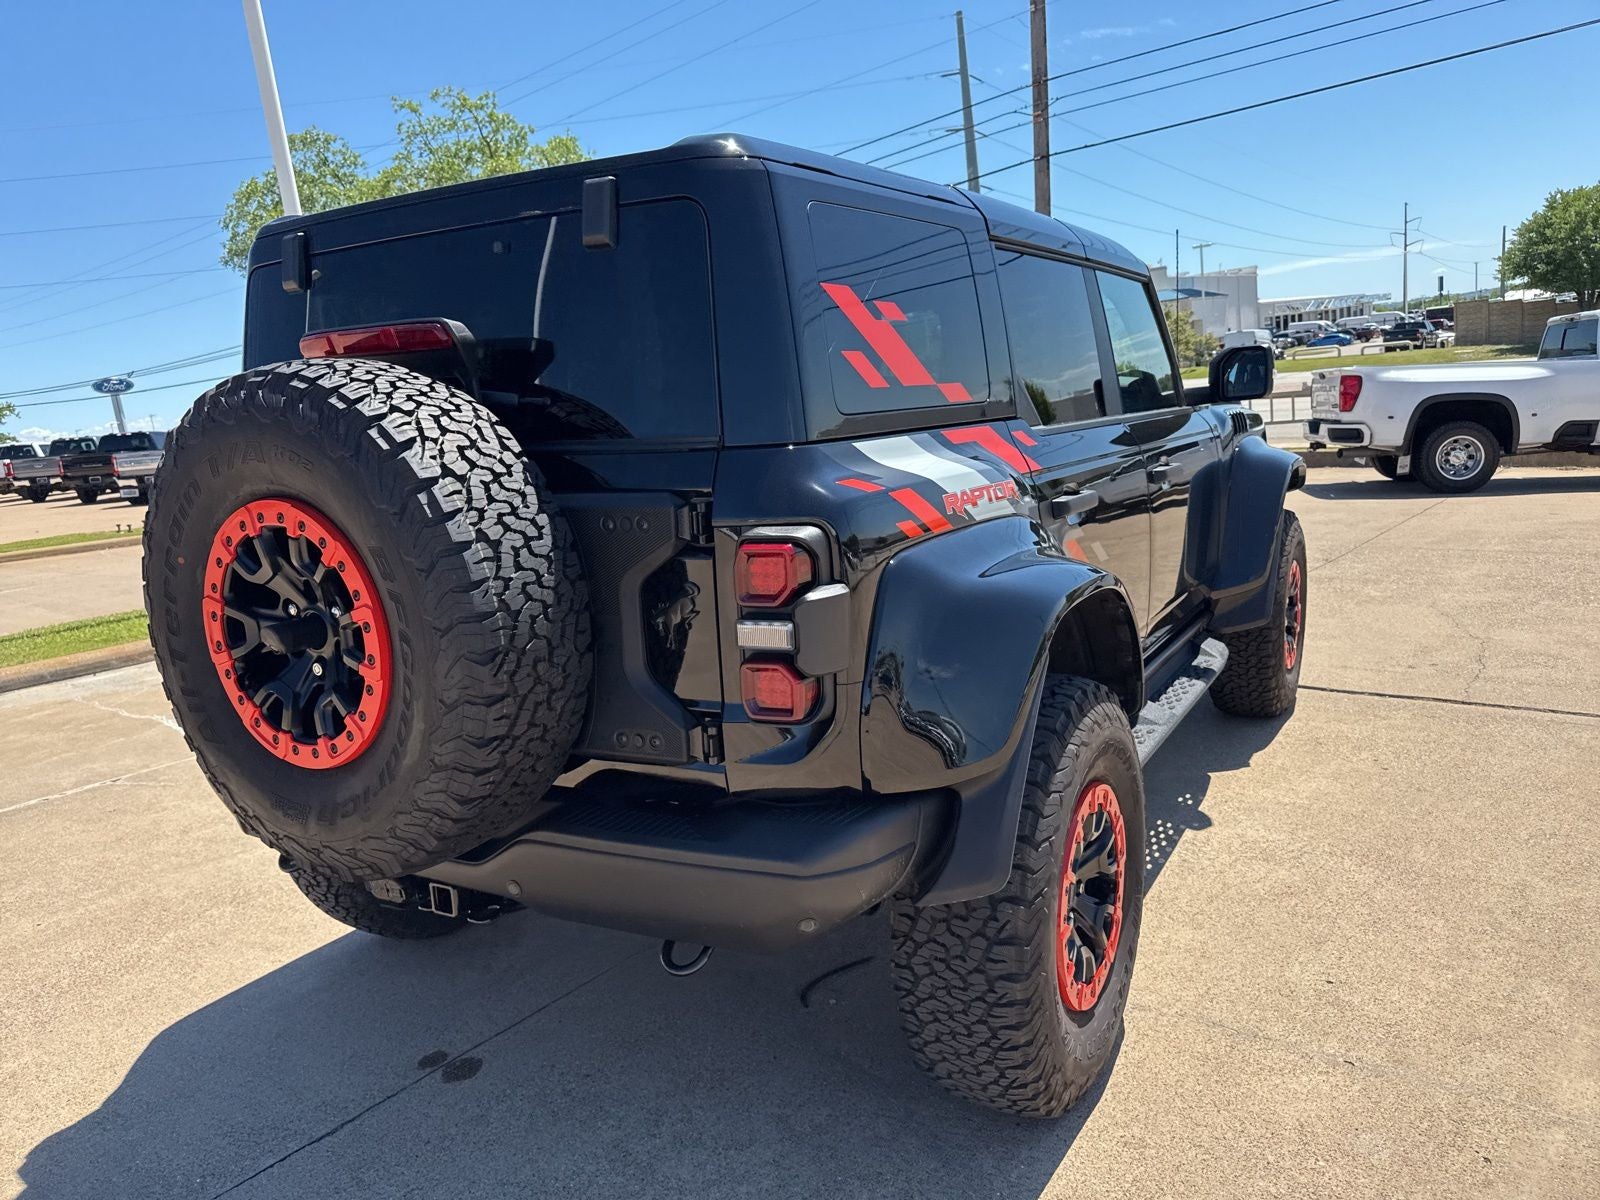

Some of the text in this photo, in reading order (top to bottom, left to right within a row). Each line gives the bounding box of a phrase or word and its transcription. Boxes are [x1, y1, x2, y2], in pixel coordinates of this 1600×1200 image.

[102, 380, 126, 391] Ford
[200, 440, 266, 481] T/A
[943, 480, 1024, 520] RAPTOR
